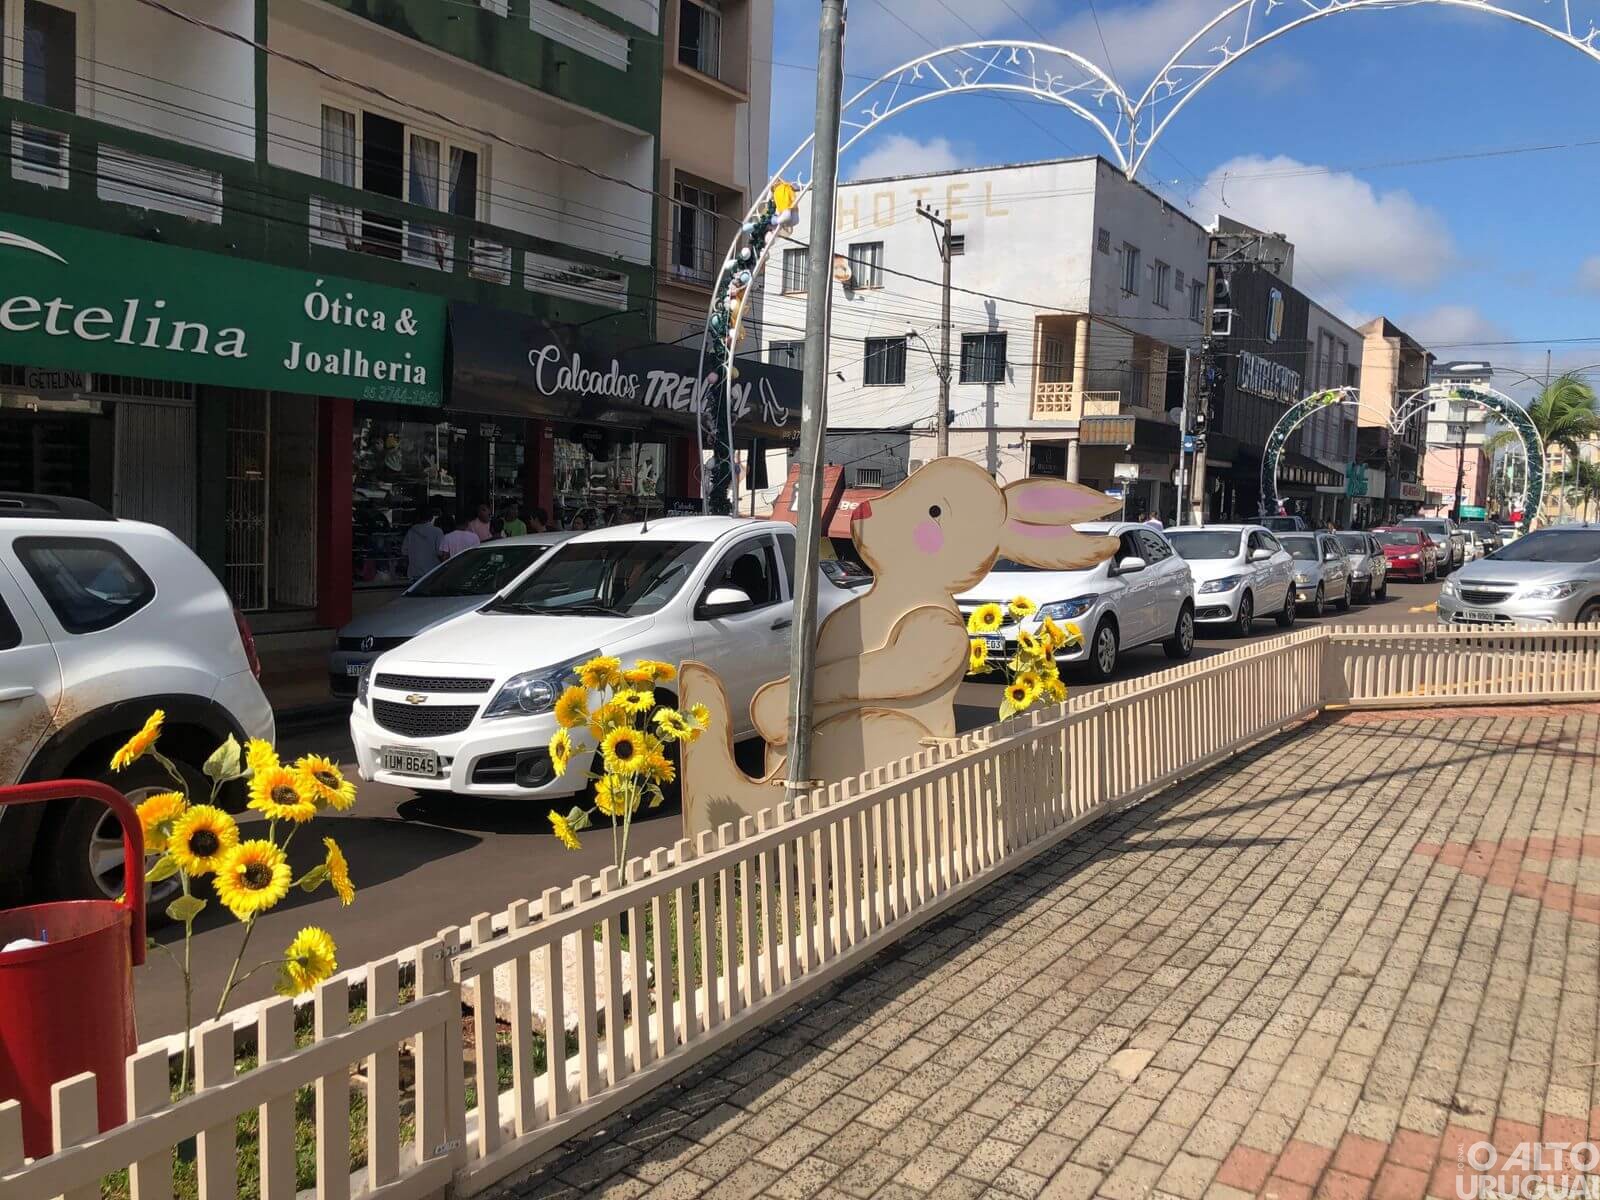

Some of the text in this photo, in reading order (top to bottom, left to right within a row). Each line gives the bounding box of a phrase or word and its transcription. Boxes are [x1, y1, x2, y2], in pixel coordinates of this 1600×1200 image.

[837, 181, 1009, 231] HOTEL
[304, 279, 418, 336] Ótica &
[29, 371, 83, 389] GETELINA
[283, 341, 427, 385] Joalheria
[528, 344, 640, 397] Calçados
